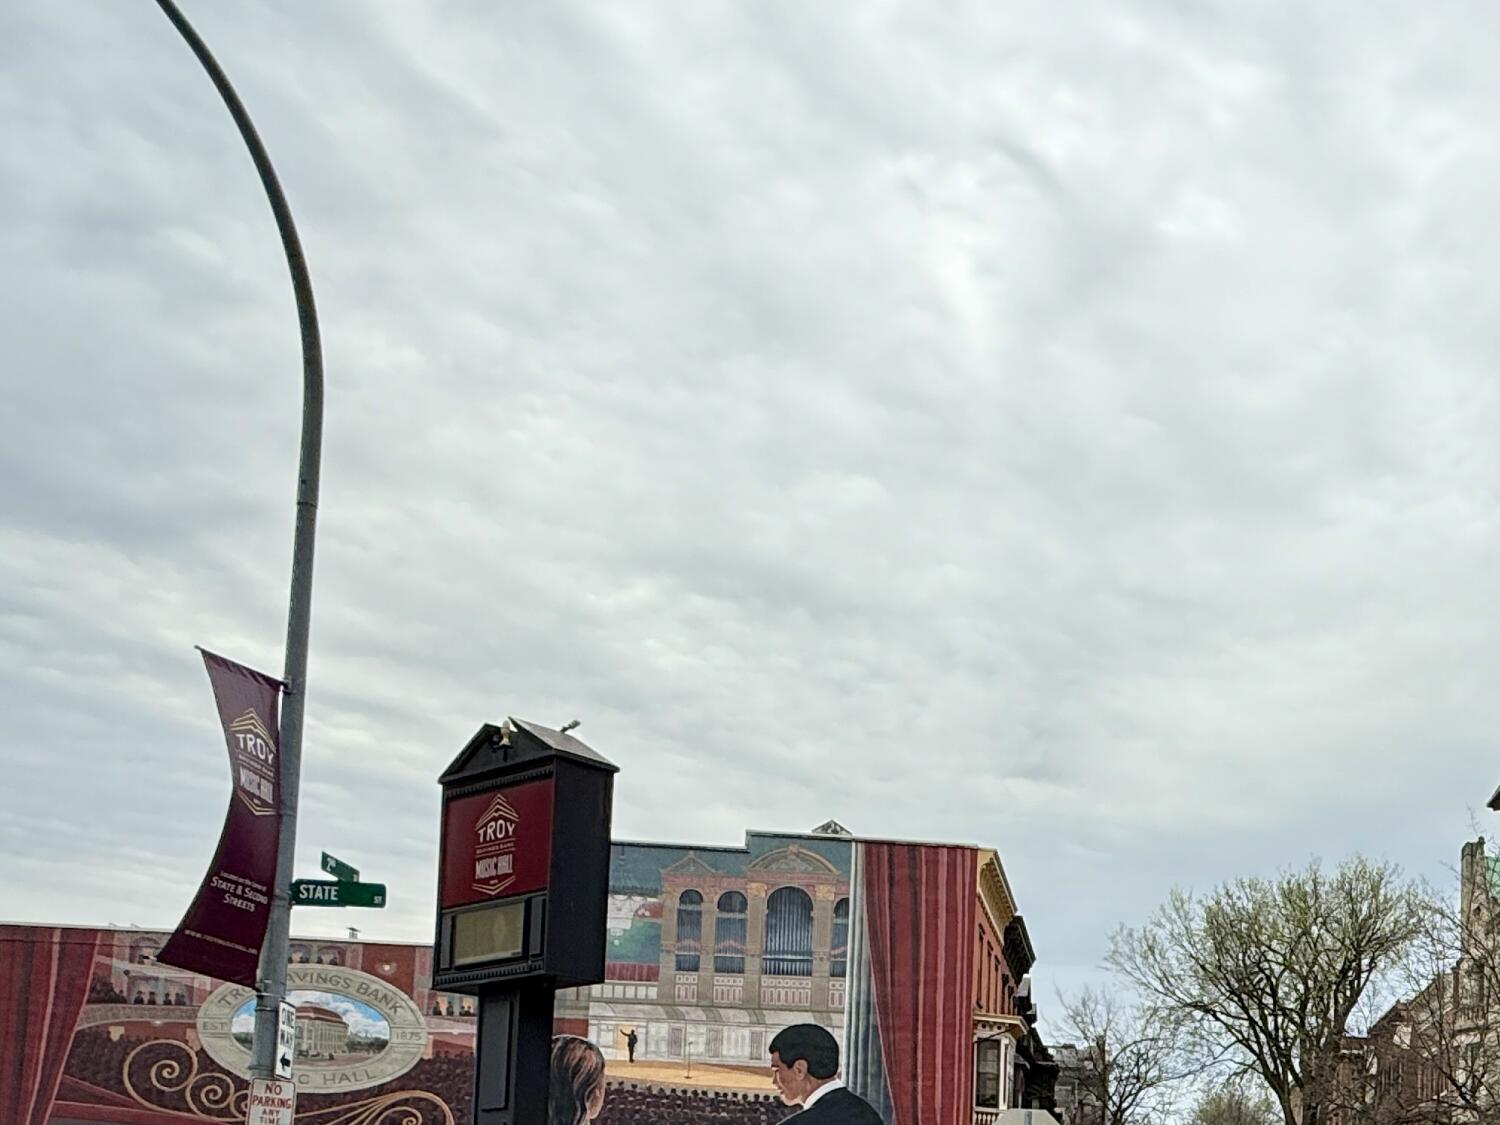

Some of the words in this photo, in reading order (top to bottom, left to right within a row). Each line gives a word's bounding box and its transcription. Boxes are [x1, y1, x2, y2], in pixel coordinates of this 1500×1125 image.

[235, 733, 274, 765] TROY
[477, 819, 517, 843] TROY
[475, 856, 498, 880] MUSIC
[497, 853, 513, 876] HALL
[210, 876, 236, 893] STATE
[243, 887, 269, 905] SECOND
[299, 884, 339, 901] STATE
[223, 893, 256, 912] STREETS
[287, 971, 353, 989] AVINGS
[355, 981, 406, 1016] BANK
[281, 1007, 295, 1029] ONE
[395, 1030, 423, 1042] 1875
[322, 1068, 378, 1086] HALL
[264, 1083, 283, 1096] NO
[252, 1094, 293, 1110] PARKING
[259, 1116, 281, 1125] TIME
[261, 1109, 281, 1118] ANY
